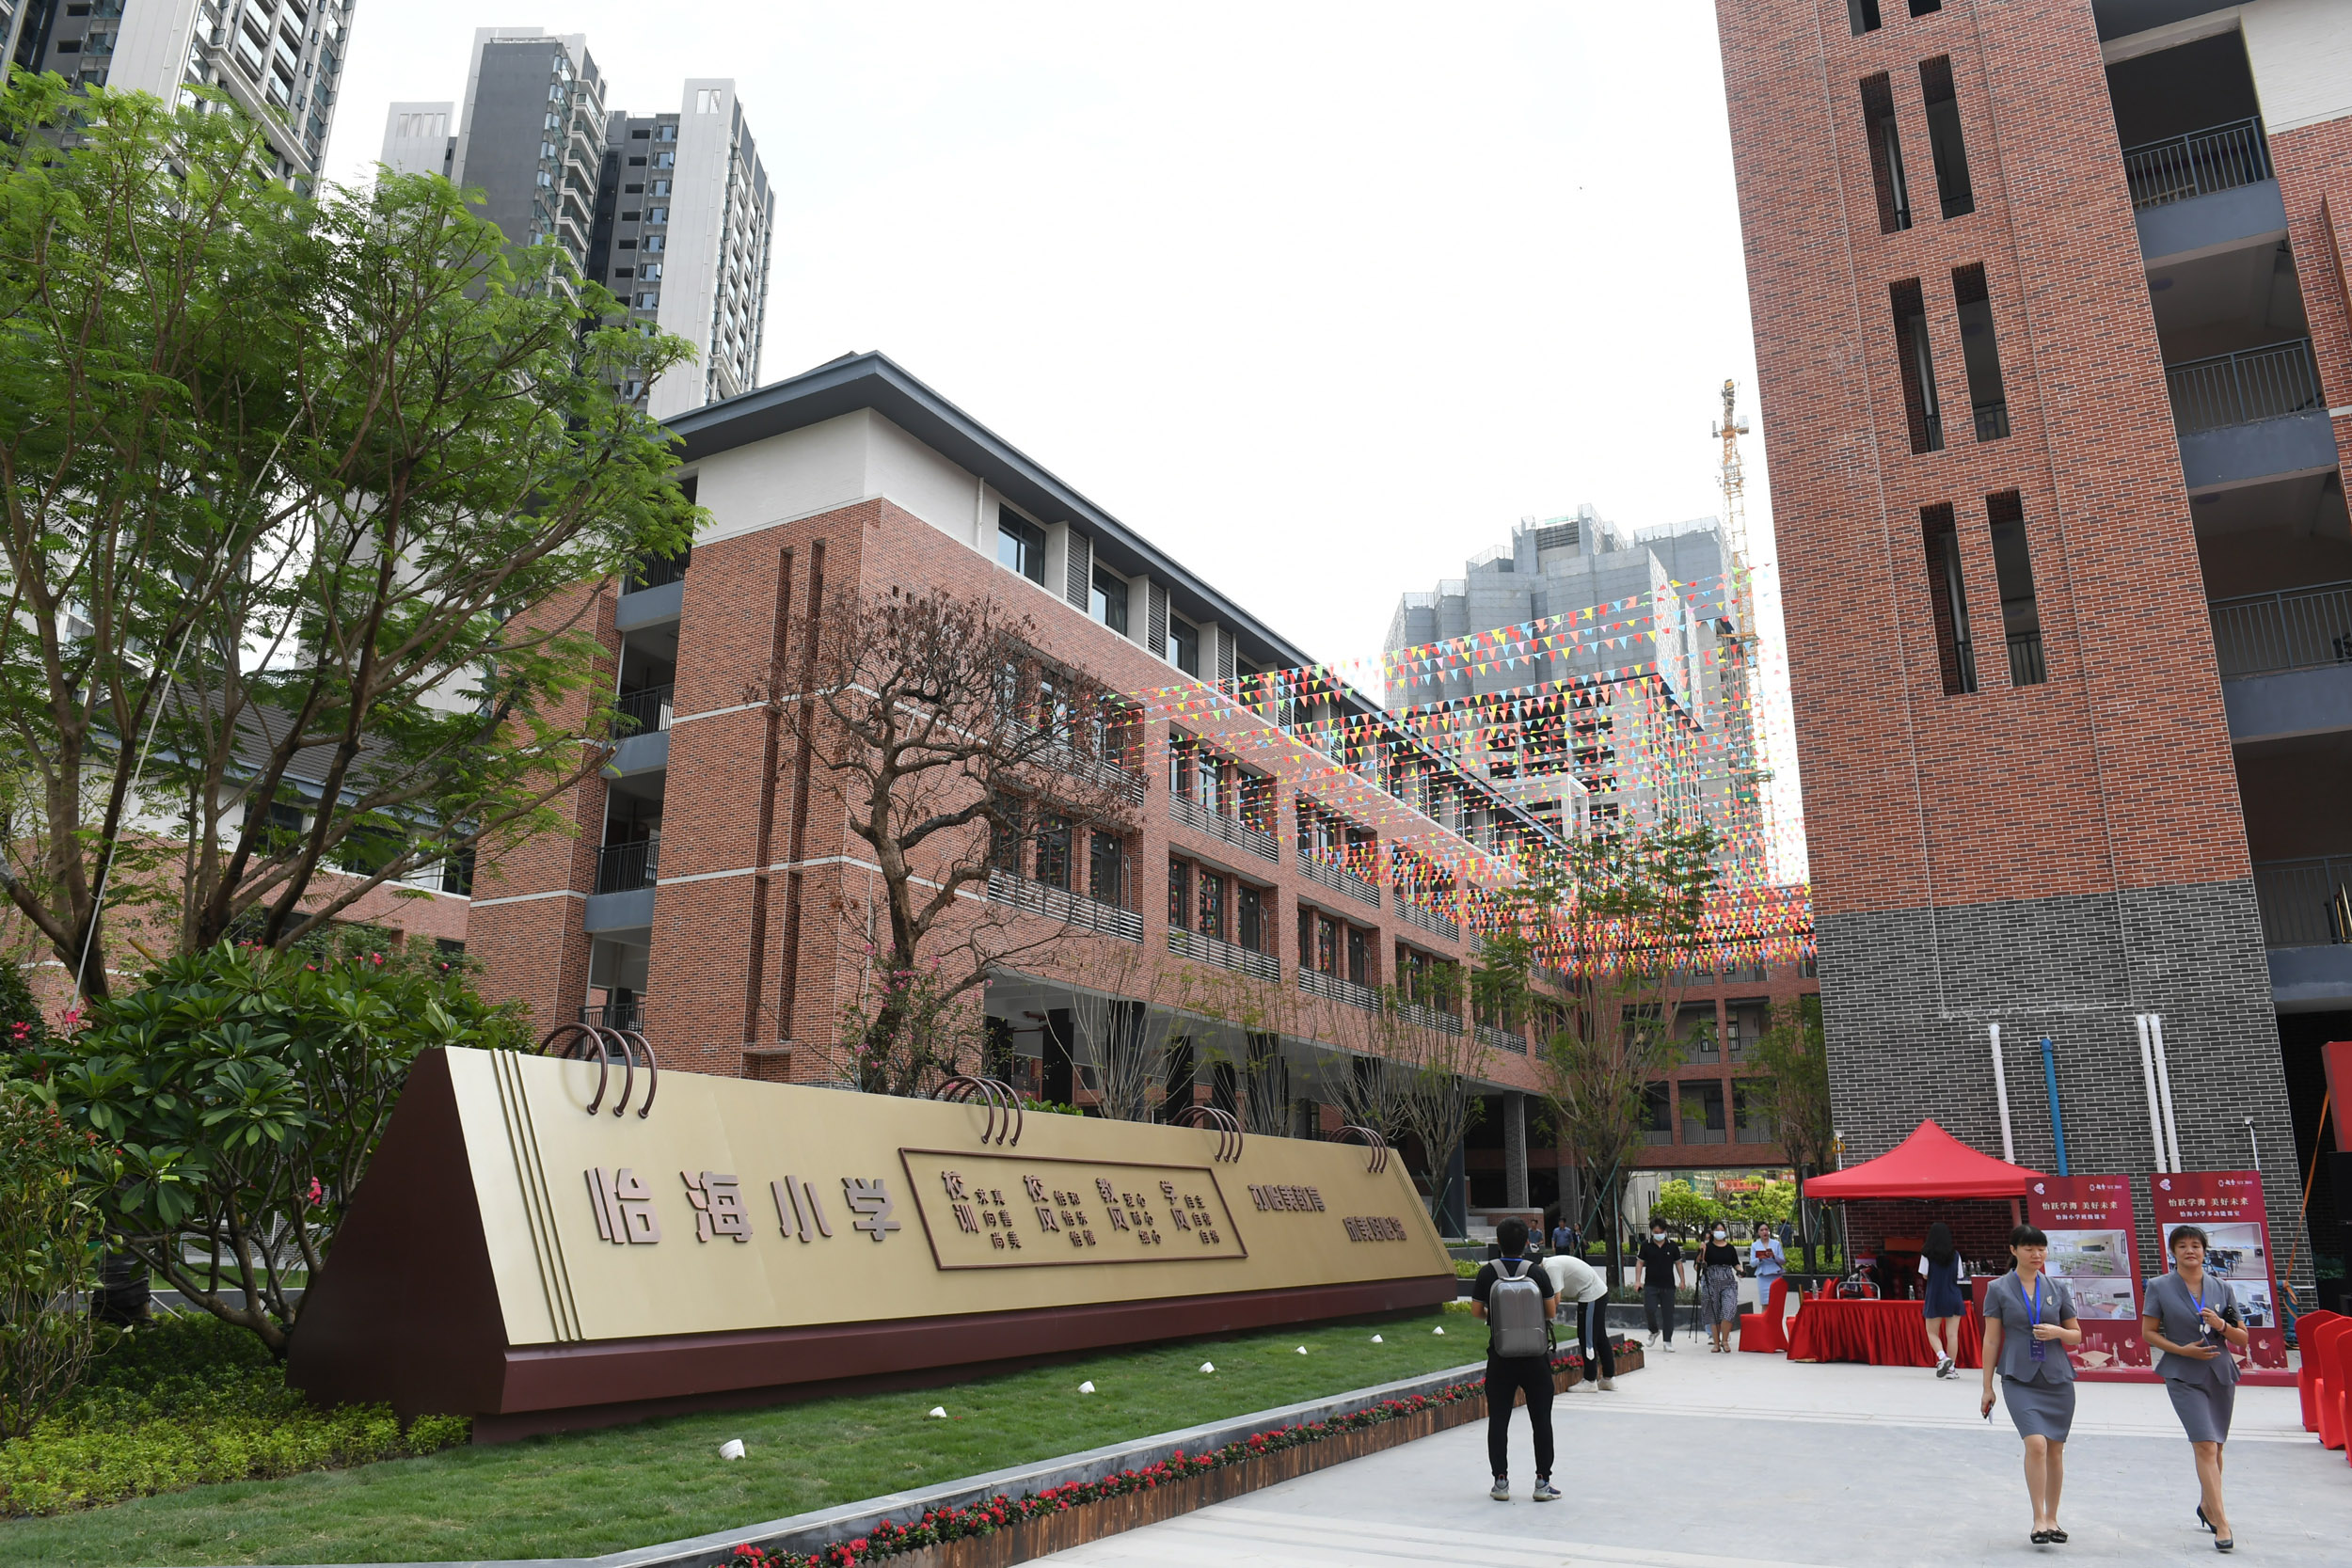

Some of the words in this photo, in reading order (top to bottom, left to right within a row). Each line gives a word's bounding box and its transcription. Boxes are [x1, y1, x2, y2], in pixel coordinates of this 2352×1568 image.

[584, 1166, 901, 1243] 怡海小学
[941, 1170, 980, 1233] 校训
[975, 1188, 1005, 1206] 求真
[1023, 1175, 1060, 1232] 校风
[1054, 1190, 1081, 1206] 怡和
[1095, 1178, 1131, 1231] 教风
[1122, 1193, 1146, 1208] 爱心
[1159, 1180, 1192, 1231] 学风
[1184, 1194, 1205, 1209] 自主
[1248, 1183, 1326, 1212] 办怡美教育
[2082, 1201, 2118, 1210] 美好未来
[2211, 1197, 2249, 1206] 美好未来
[983, 1209, 1013, 1227] 向善
[1061, 1210, 1088, 1227] 怡乐
[991, 1231, 1022, 1249] 尚美
